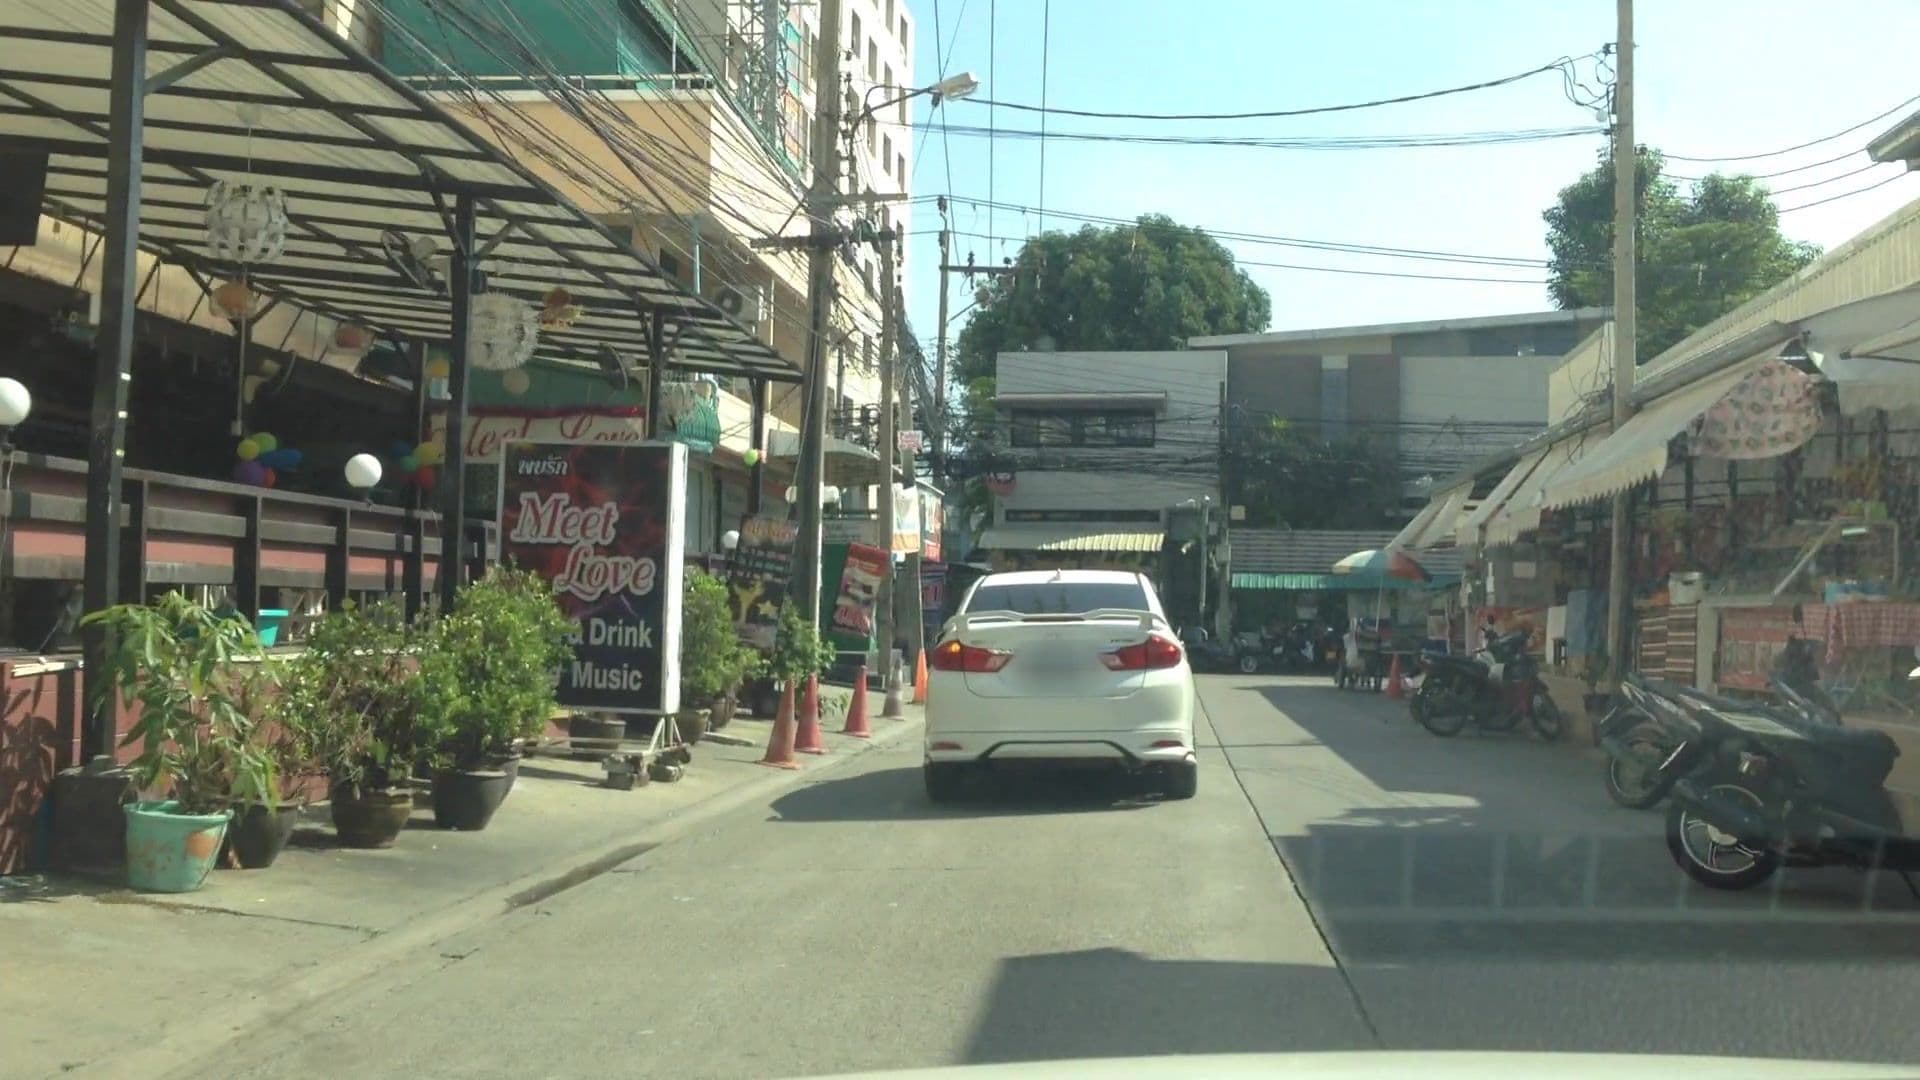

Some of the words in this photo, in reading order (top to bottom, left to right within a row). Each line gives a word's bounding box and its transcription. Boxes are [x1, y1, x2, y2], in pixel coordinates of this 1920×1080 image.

[517, 455, 569, 475] พบรัก
[510, 491, 619, 545] Meet
[551, 544, 656, 601] Love
[589, 617, 653, 649] Drink
[571, 660, 643, 691] Music
